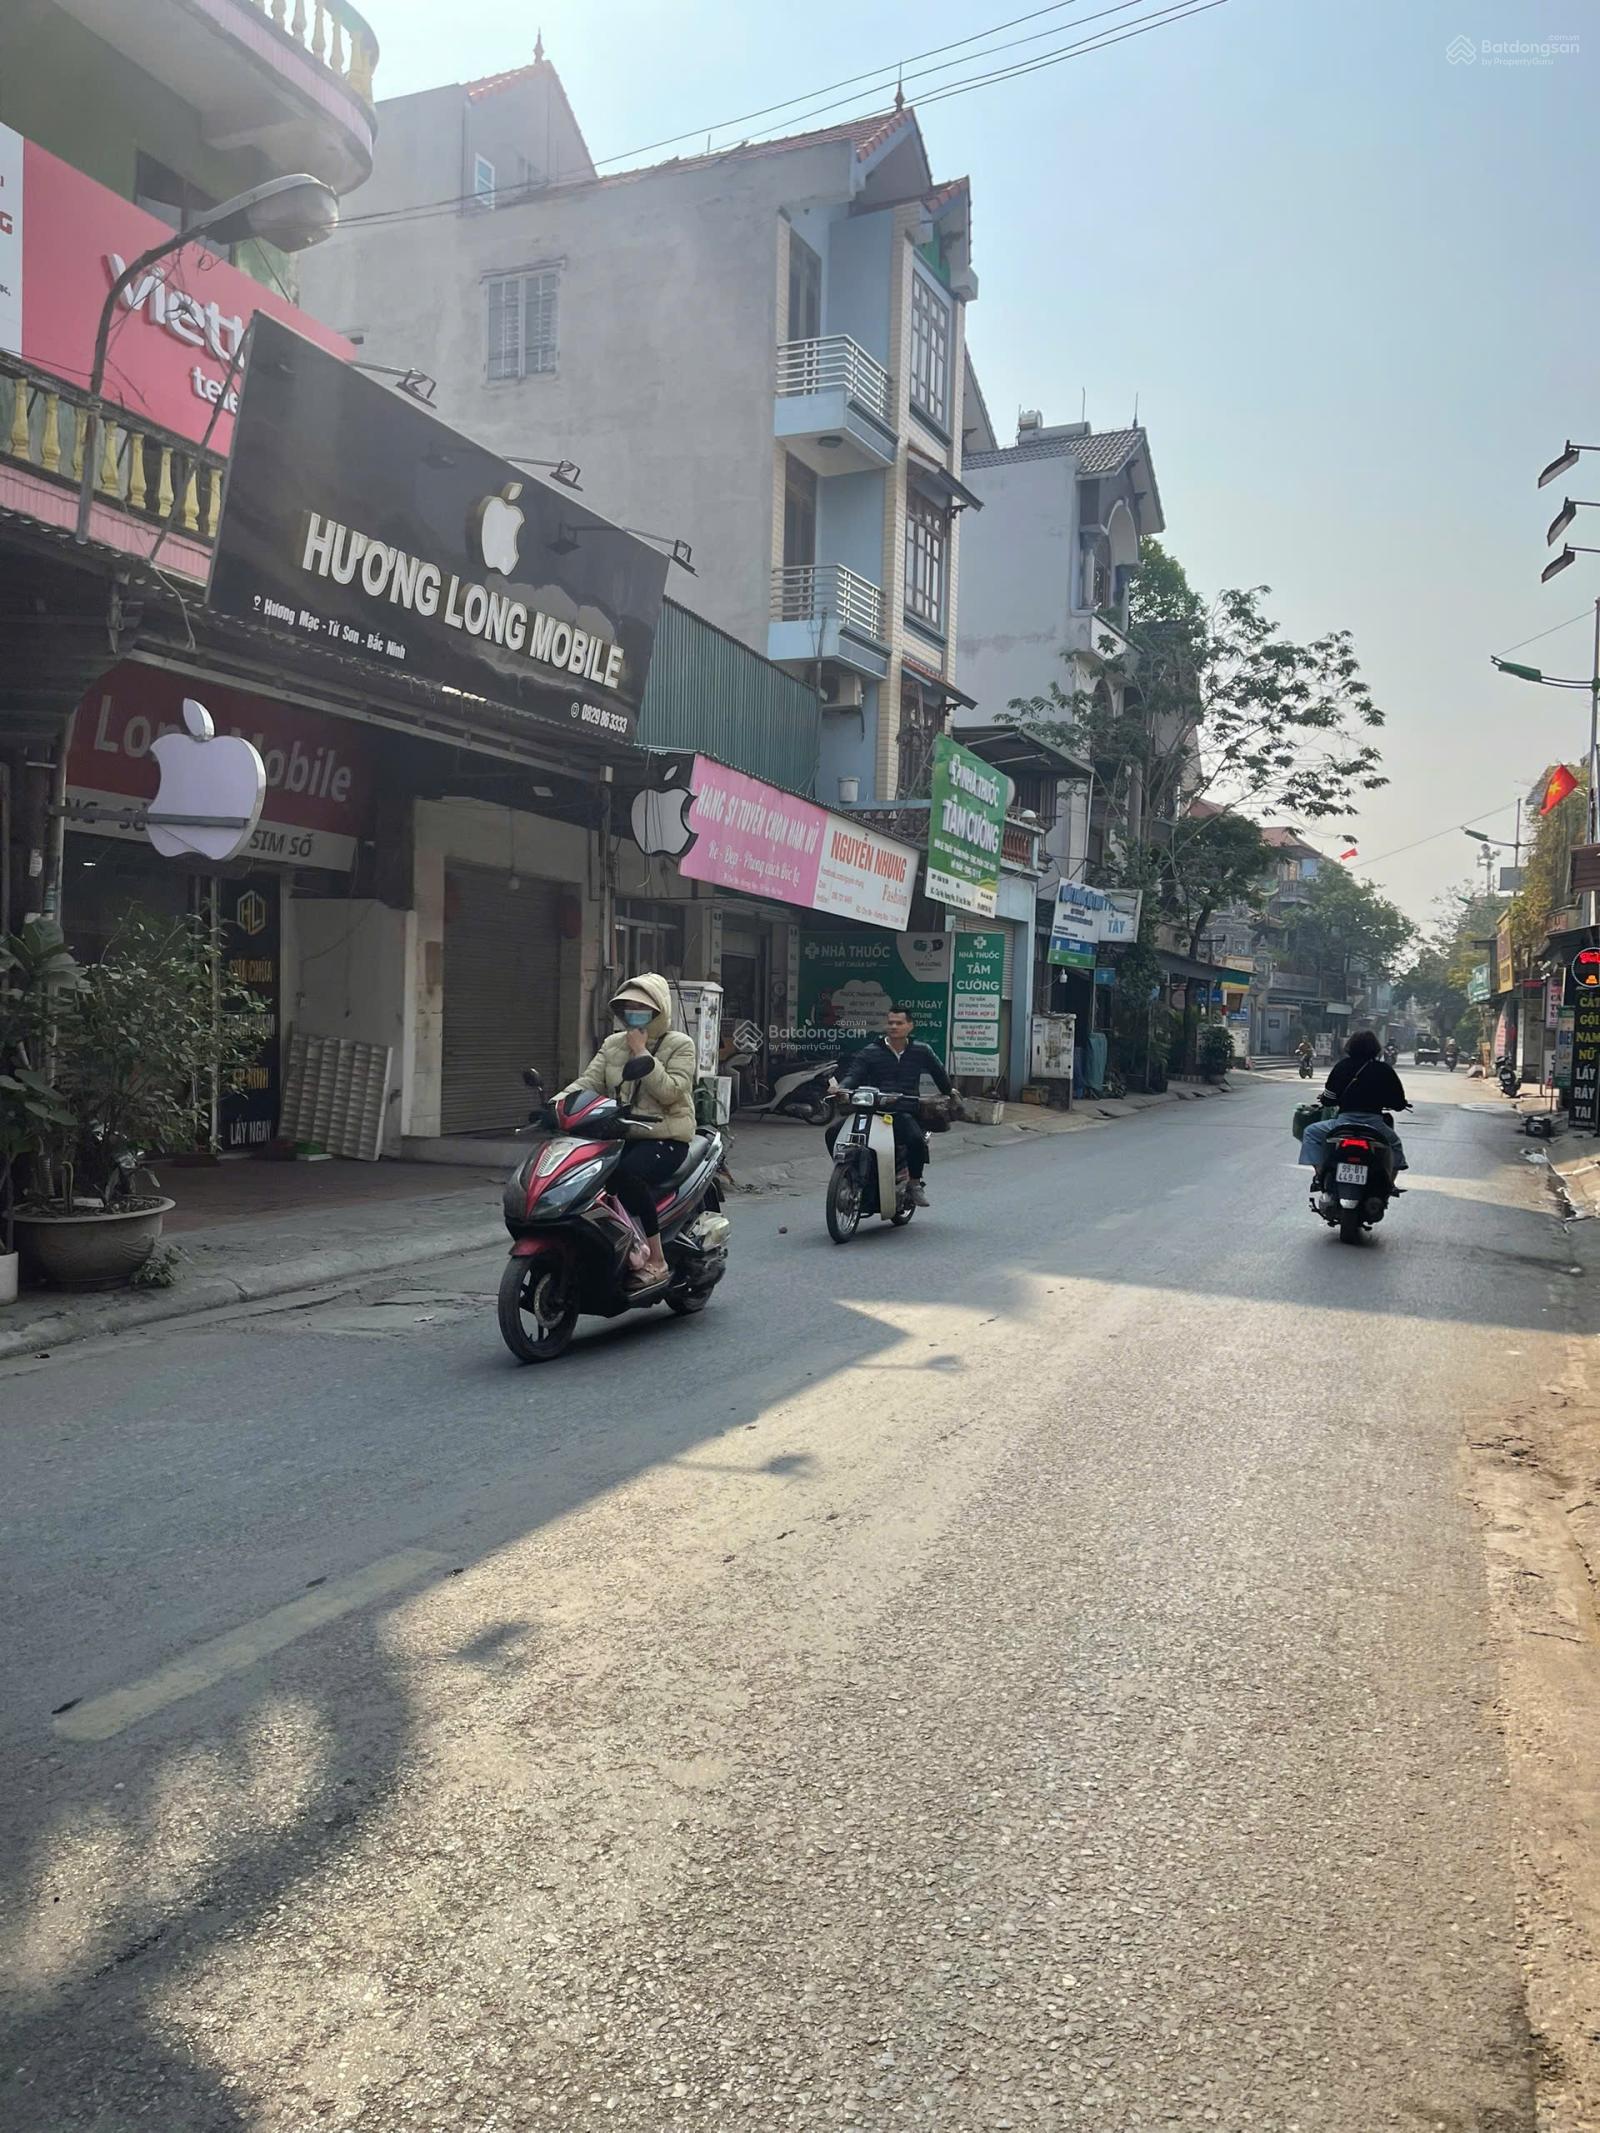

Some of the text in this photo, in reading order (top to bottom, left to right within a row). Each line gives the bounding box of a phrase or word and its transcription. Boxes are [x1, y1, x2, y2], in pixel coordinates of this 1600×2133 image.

[106, 253, 246, 368] Viett
[191, 366, 238, 414] tele
[302, 512, 625, 689] HƯƠNG LONG MOBILE
[263, 598, 406, 660] Hương Mạc Từ Sơn Bắc Ninh
[93, 694, 351, 803] Lo obile
[249, 830, 285, 853] SIM
[830, 831, 875, 872] NGUYỄN
[873, 847, 907, 884] NHUNG
[821, 942, 891, 958] NHÀ THUỐC
[958, 950, 1000, 959] NHÀ THUỐC
[966, 962, 991, 974] TÂM
[956, 979, 1000, 991] CƯỜNG
[916, 1000, 943, 1009] NGAY
[1575, 1064, 1596, 1081] LẤY
[1573, 1084, 1595, 1099] RÁY
[1574, 1105, 1592, 1119] TAI
